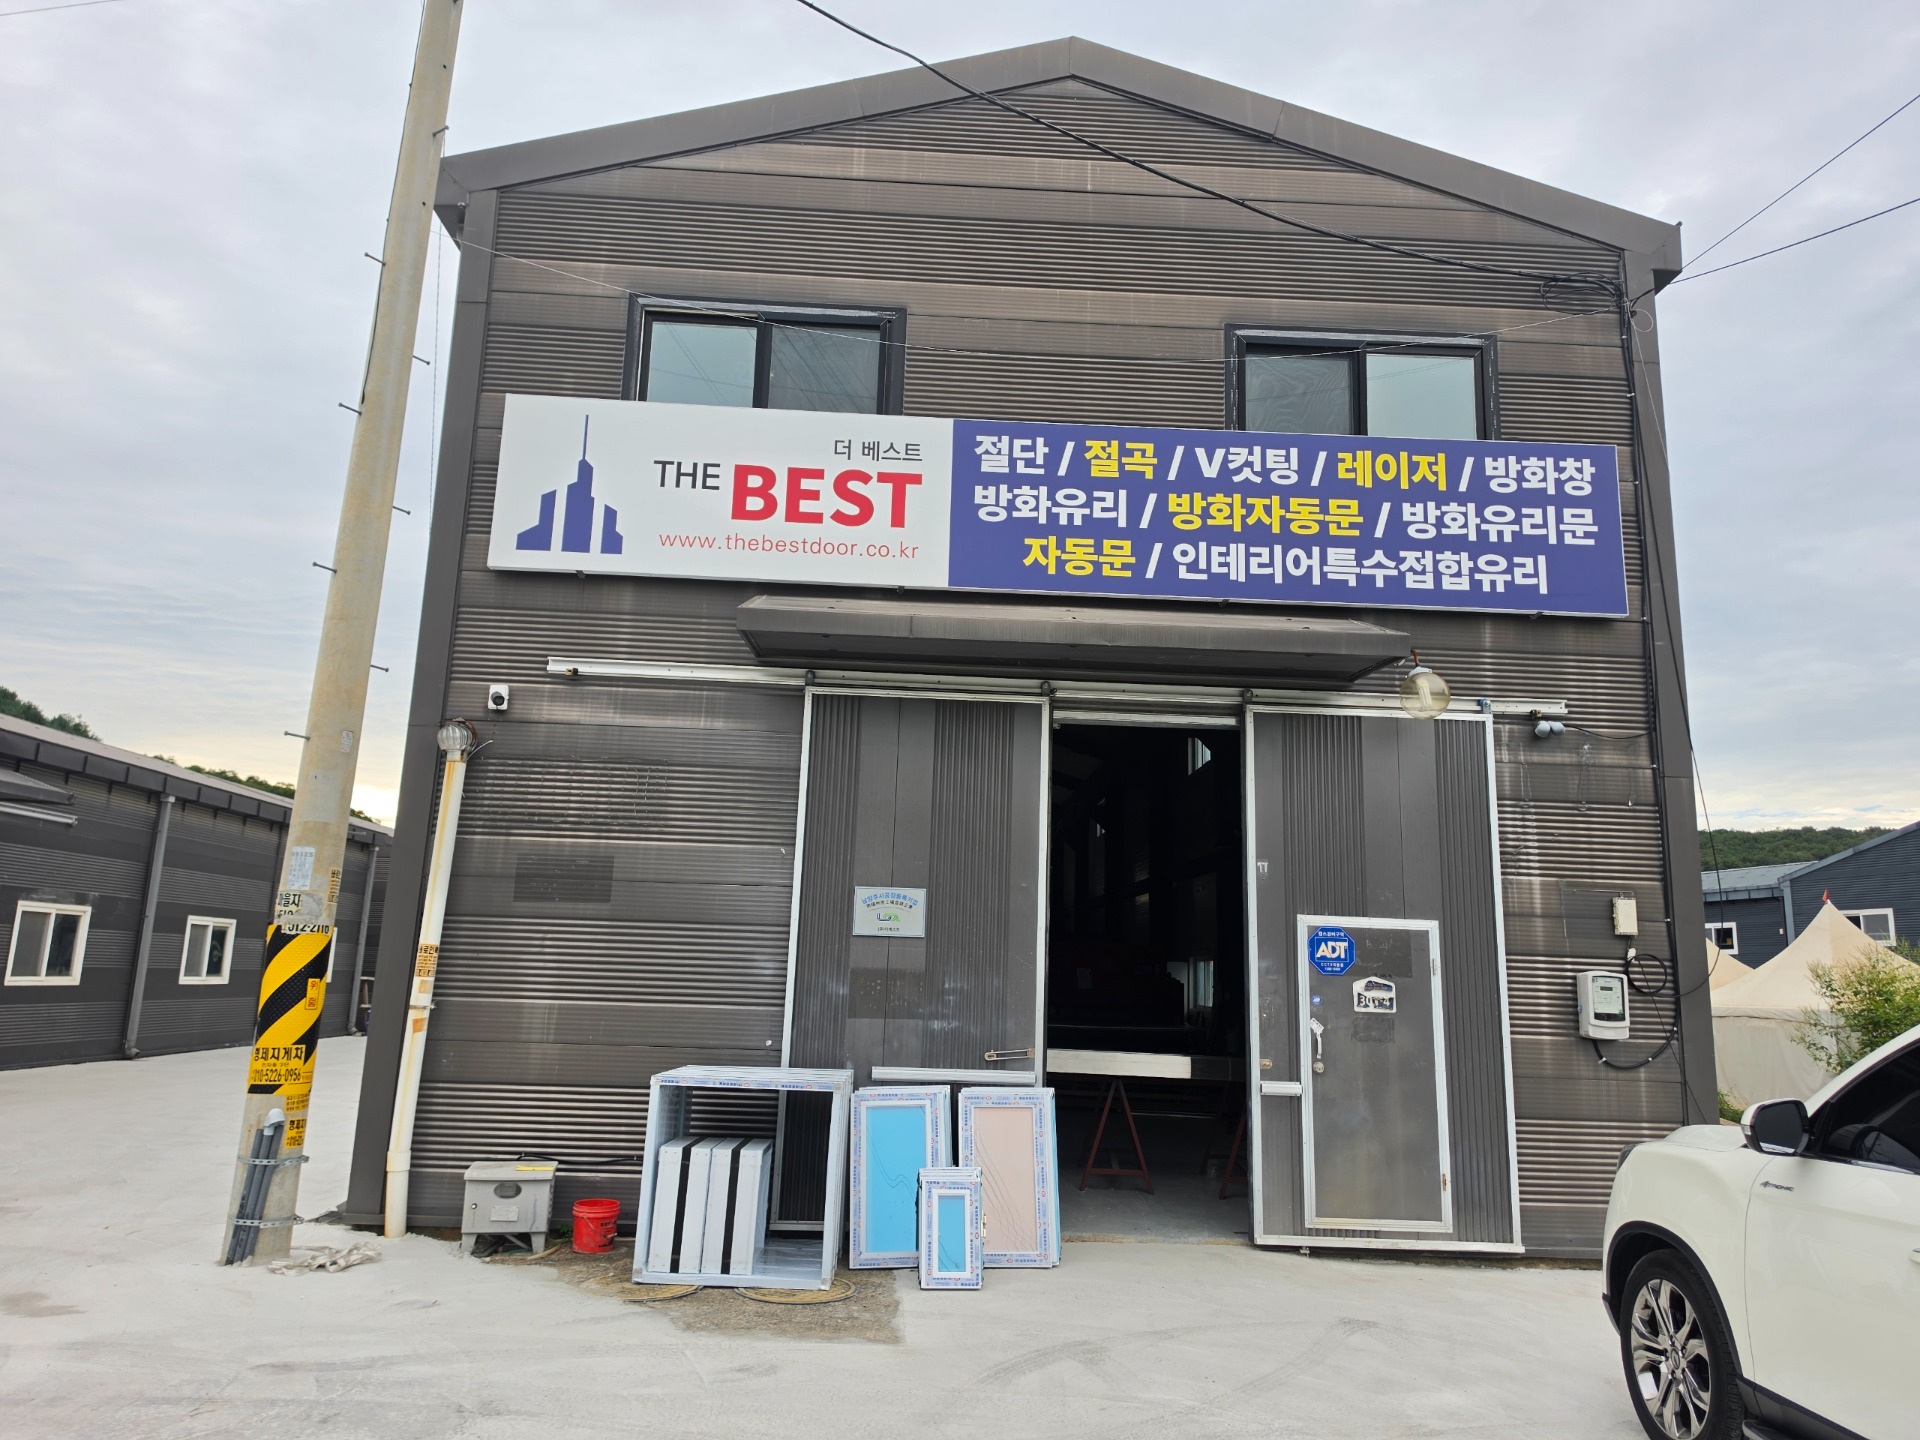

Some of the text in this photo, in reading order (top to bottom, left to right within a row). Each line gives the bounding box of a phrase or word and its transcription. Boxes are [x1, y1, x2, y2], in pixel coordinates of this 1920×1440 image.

[834, 439, 923, 462] 더 베스트
[974, 436, 1049, 475] 절단
[1084, 440, 1158, 480] 절곡
[1195, 446, 1299, 486] V컷팅
[1337, 451, 1447, 491] 레이저
[1485, 456, 1596, 496] 방화창
[653, 459, 923, 529] THE BEST
[974, 484, 1127, 528] 방화유리
[1168, 492, 1364, 537] 방화자동문
[1402, 501, 1599, 546] 방화유리문
[659, 532, 919, 560] www.thebestdoor.co.kr
[1022, 535, 1136, 578] 자동문
[1173, 542, 1548, 594] 인테리어특수접합유리
[1315, 941, 1348, 959] ADT
